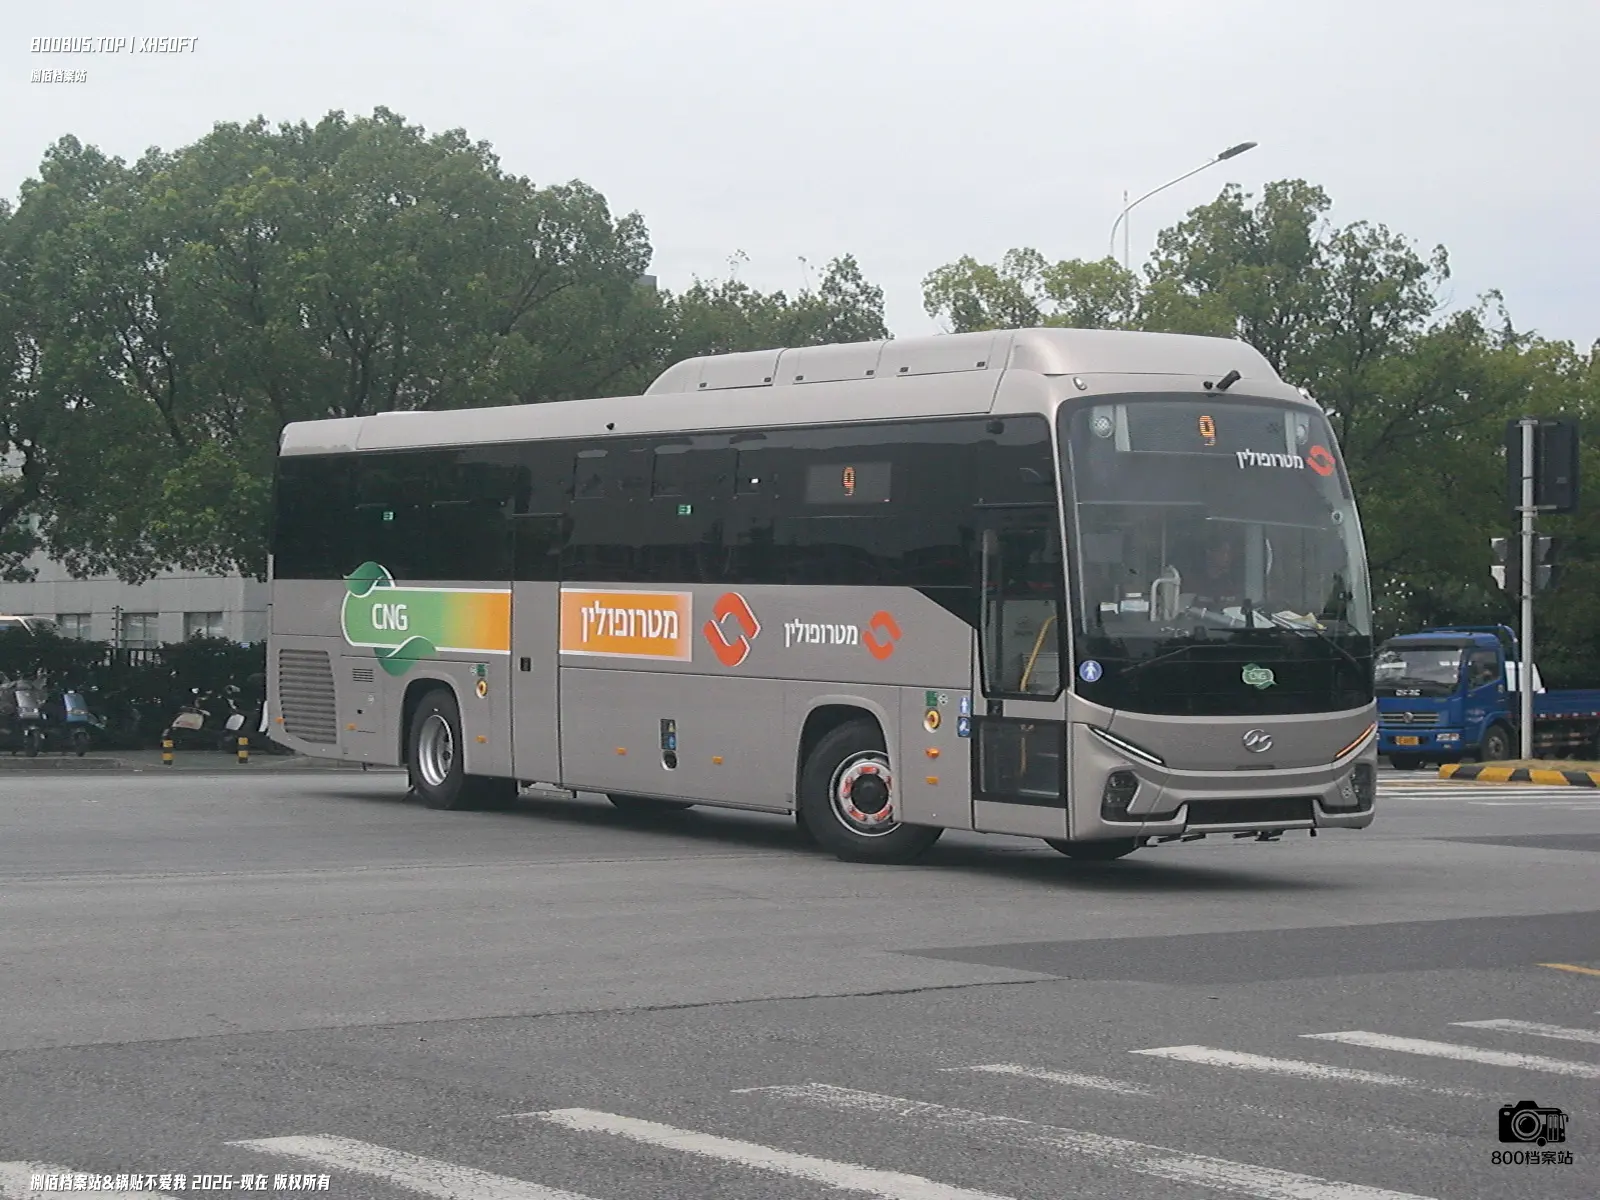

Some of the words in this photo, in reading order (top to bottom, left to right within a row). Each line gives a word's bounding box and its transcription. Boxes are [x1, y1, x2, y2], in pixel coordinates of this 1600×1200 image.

[1199, 415, 1215, 446] 9
[1236, 448, 1304, 469] מטרופולין
[843, 466, 855, 496] 9
[371, 603, 408, 631] CNG
[580, 600, 678, 643] מטרופולין
[784, 618, 858, 648] מטרופולין
